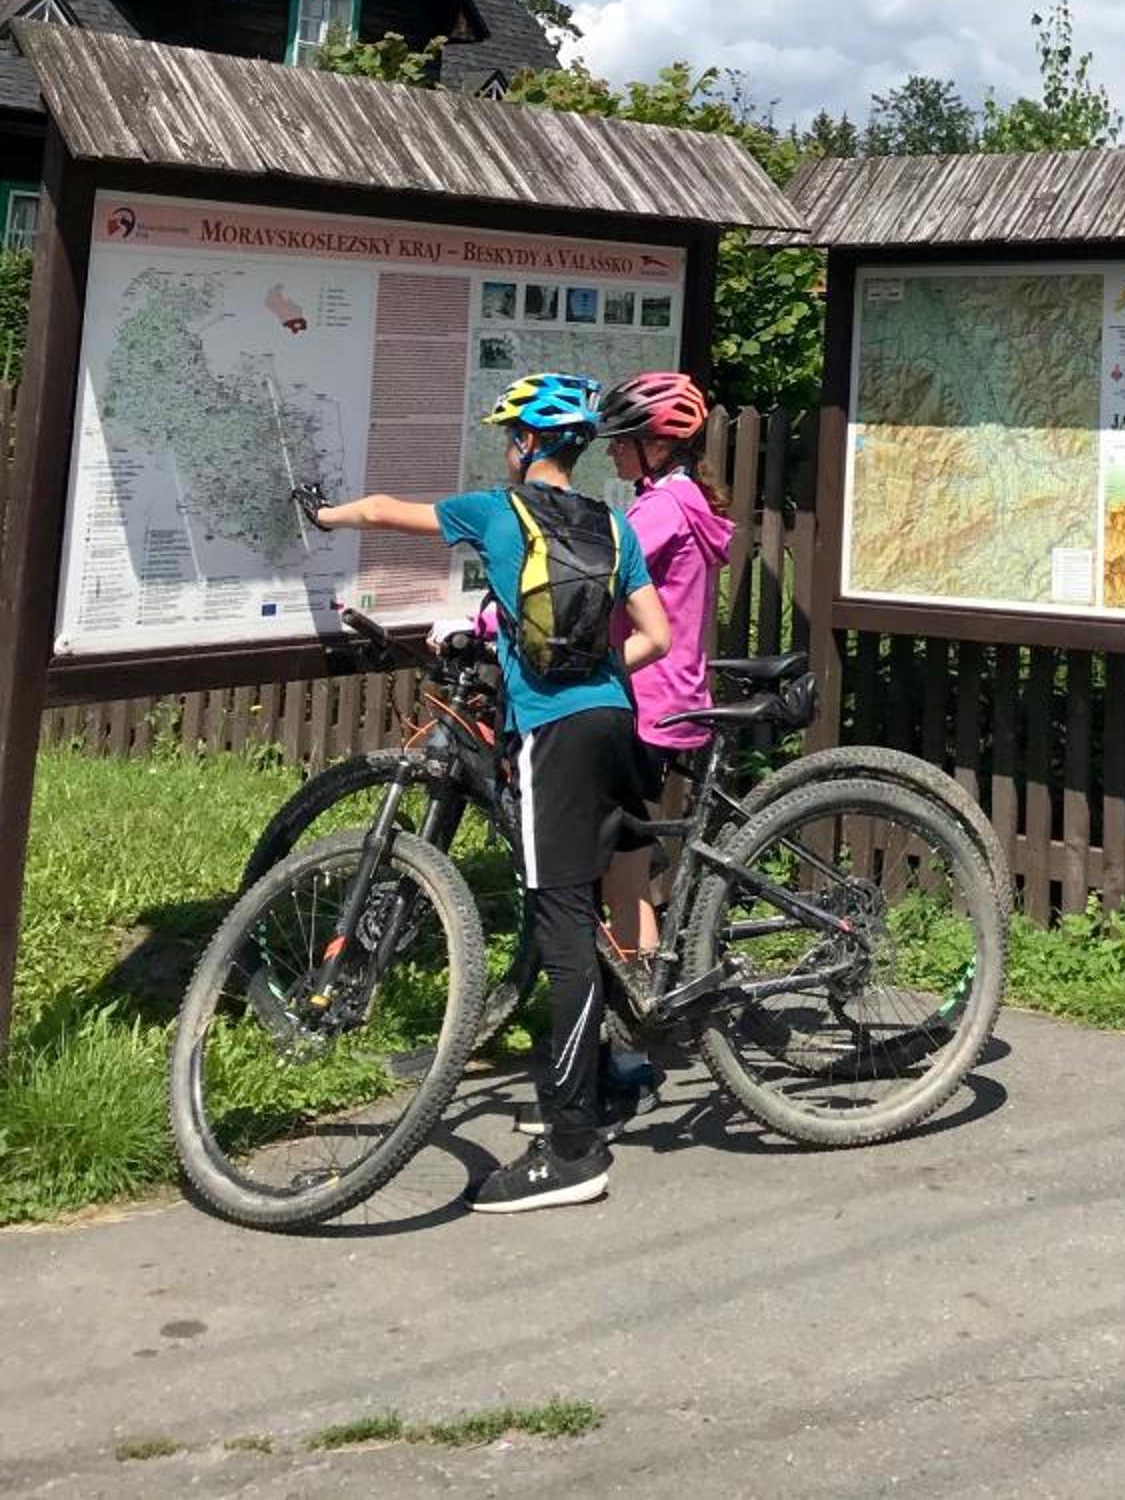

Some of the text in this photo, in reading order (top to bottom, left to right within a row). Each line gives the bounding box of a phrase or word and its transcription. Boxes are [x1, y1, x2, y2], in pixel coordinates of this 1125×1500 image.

[399, 239, 442, 262] KRAJ
[463, 241, 538, 267] BESKYDY
[543, 254, 555, 268] A
